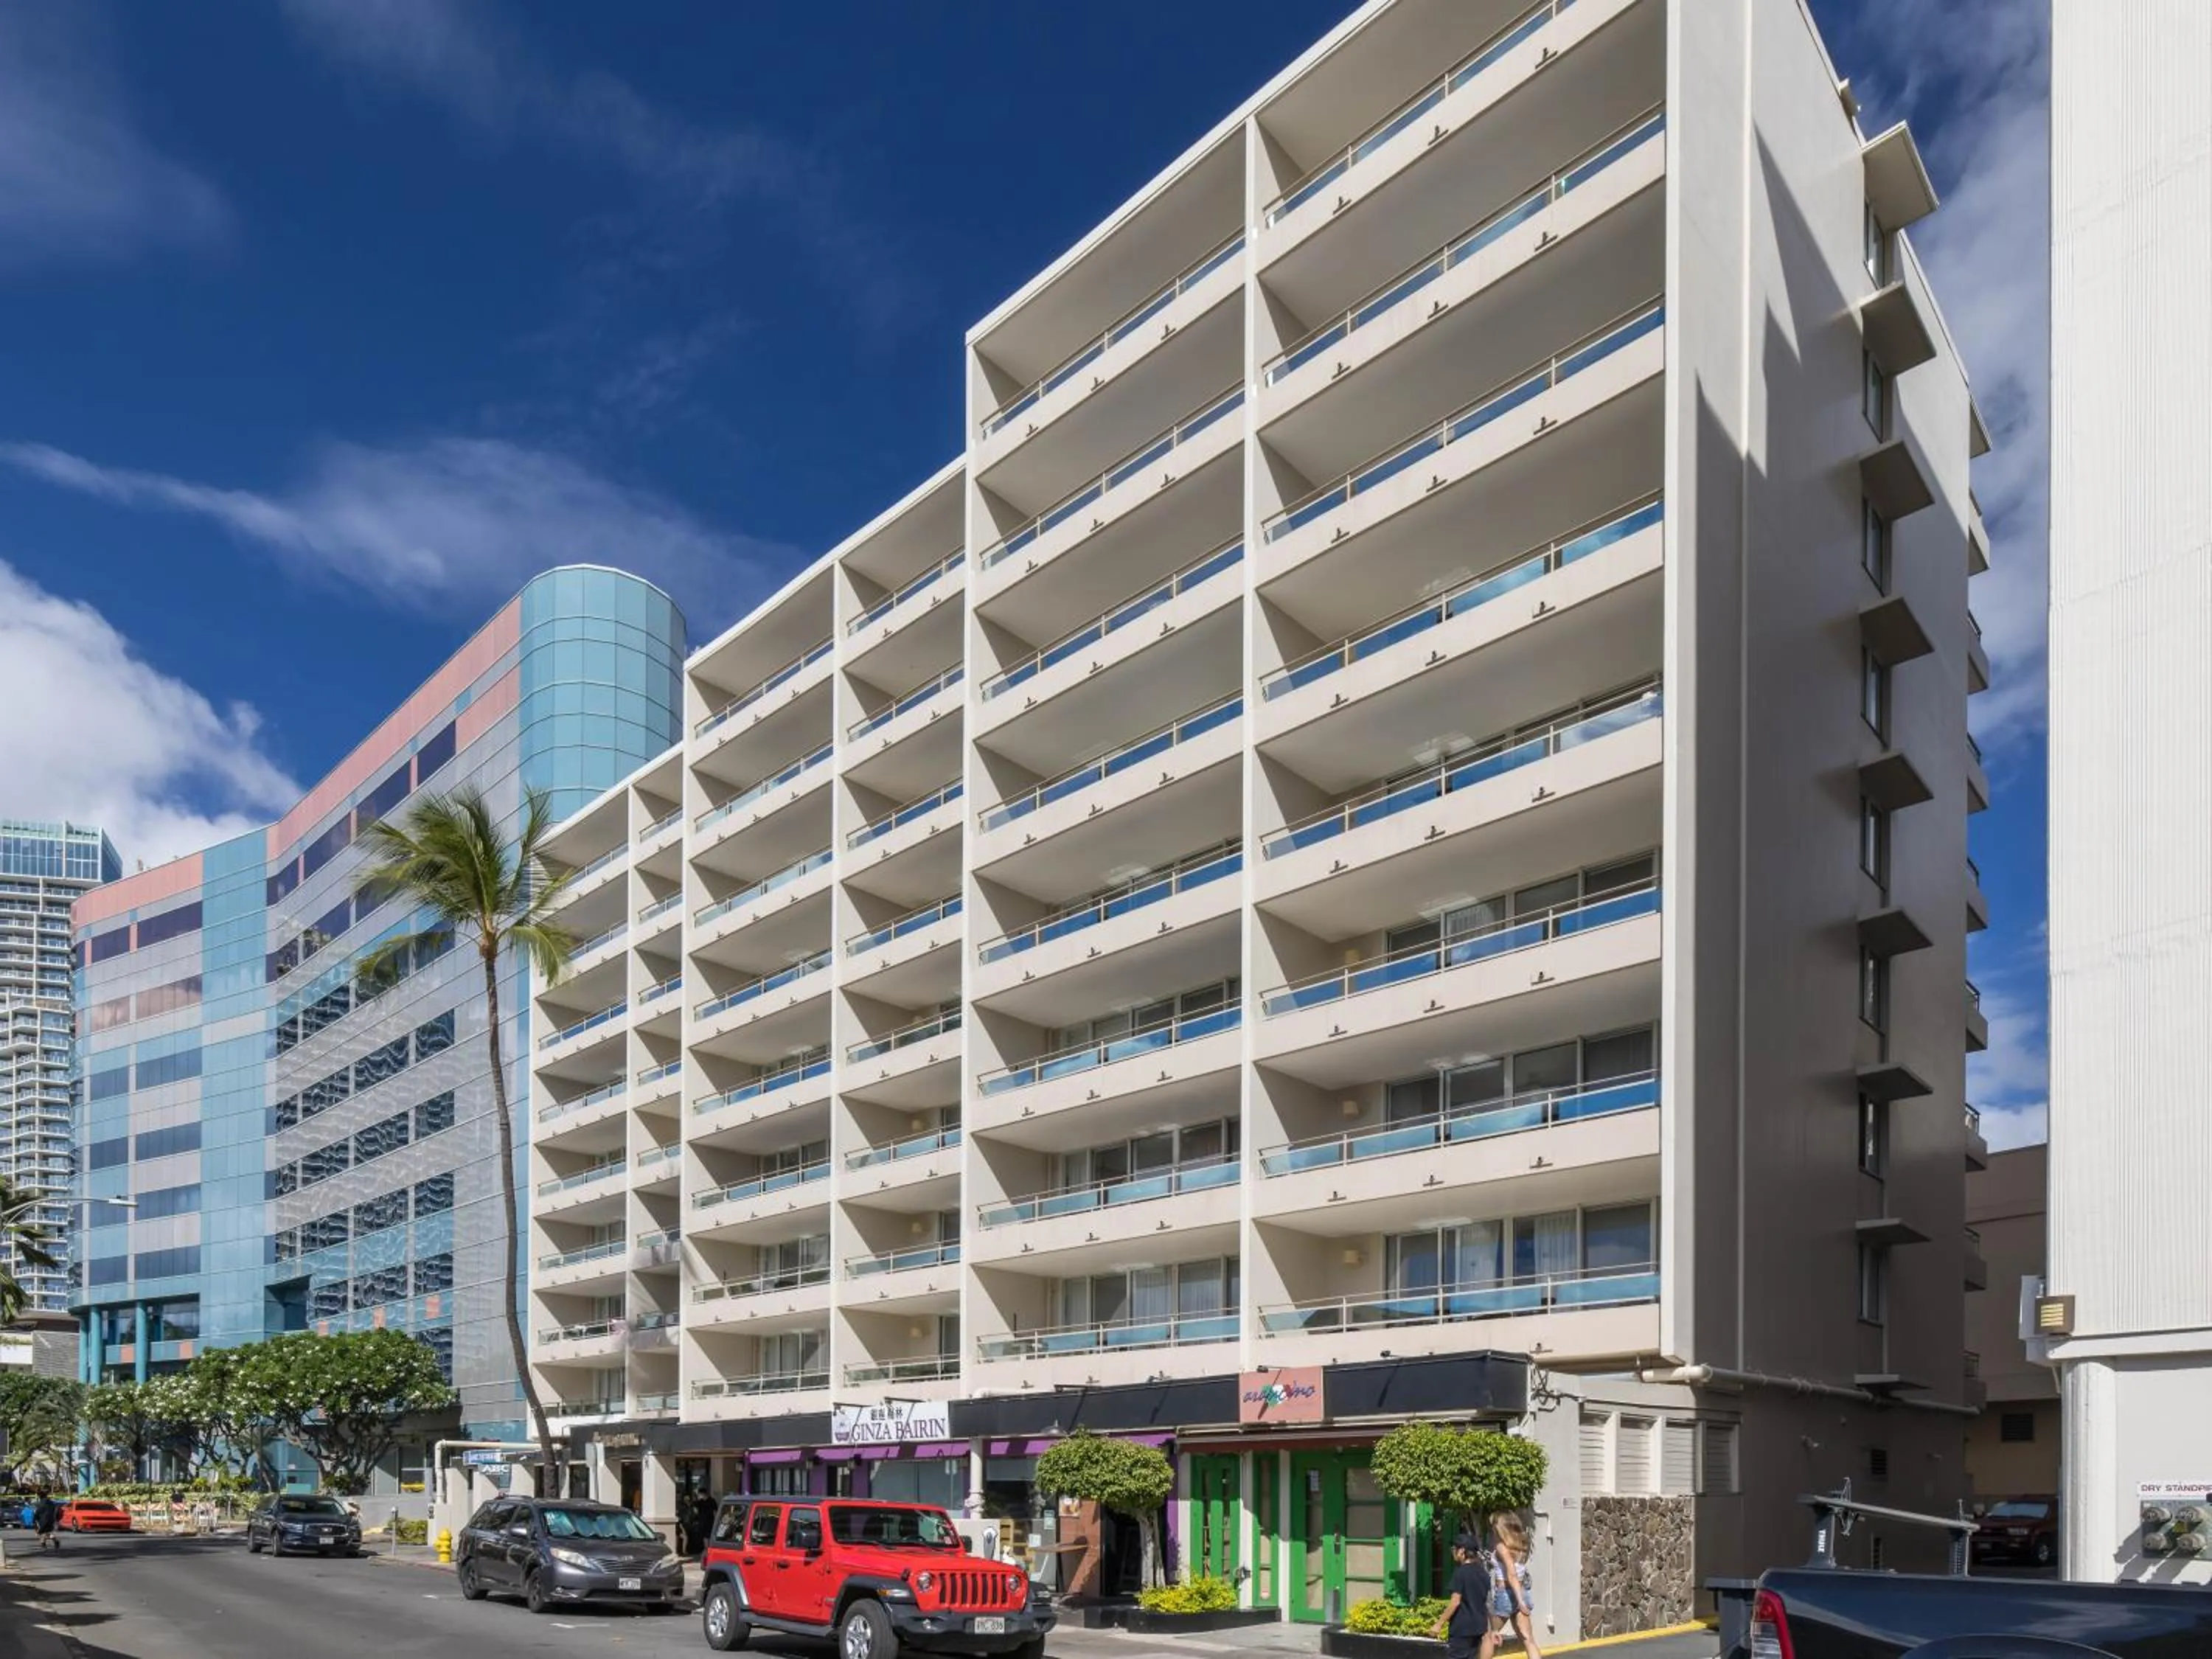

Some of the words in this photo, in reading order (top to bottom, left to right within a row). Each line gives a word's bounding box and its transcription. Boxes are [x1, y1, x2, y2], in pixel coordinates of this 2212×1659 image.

[852, 1420, 891, 1441] GINZA
[895, 1418, 946, 1440] BAIRIN
[481, 1464, 509, 1472] ABC
